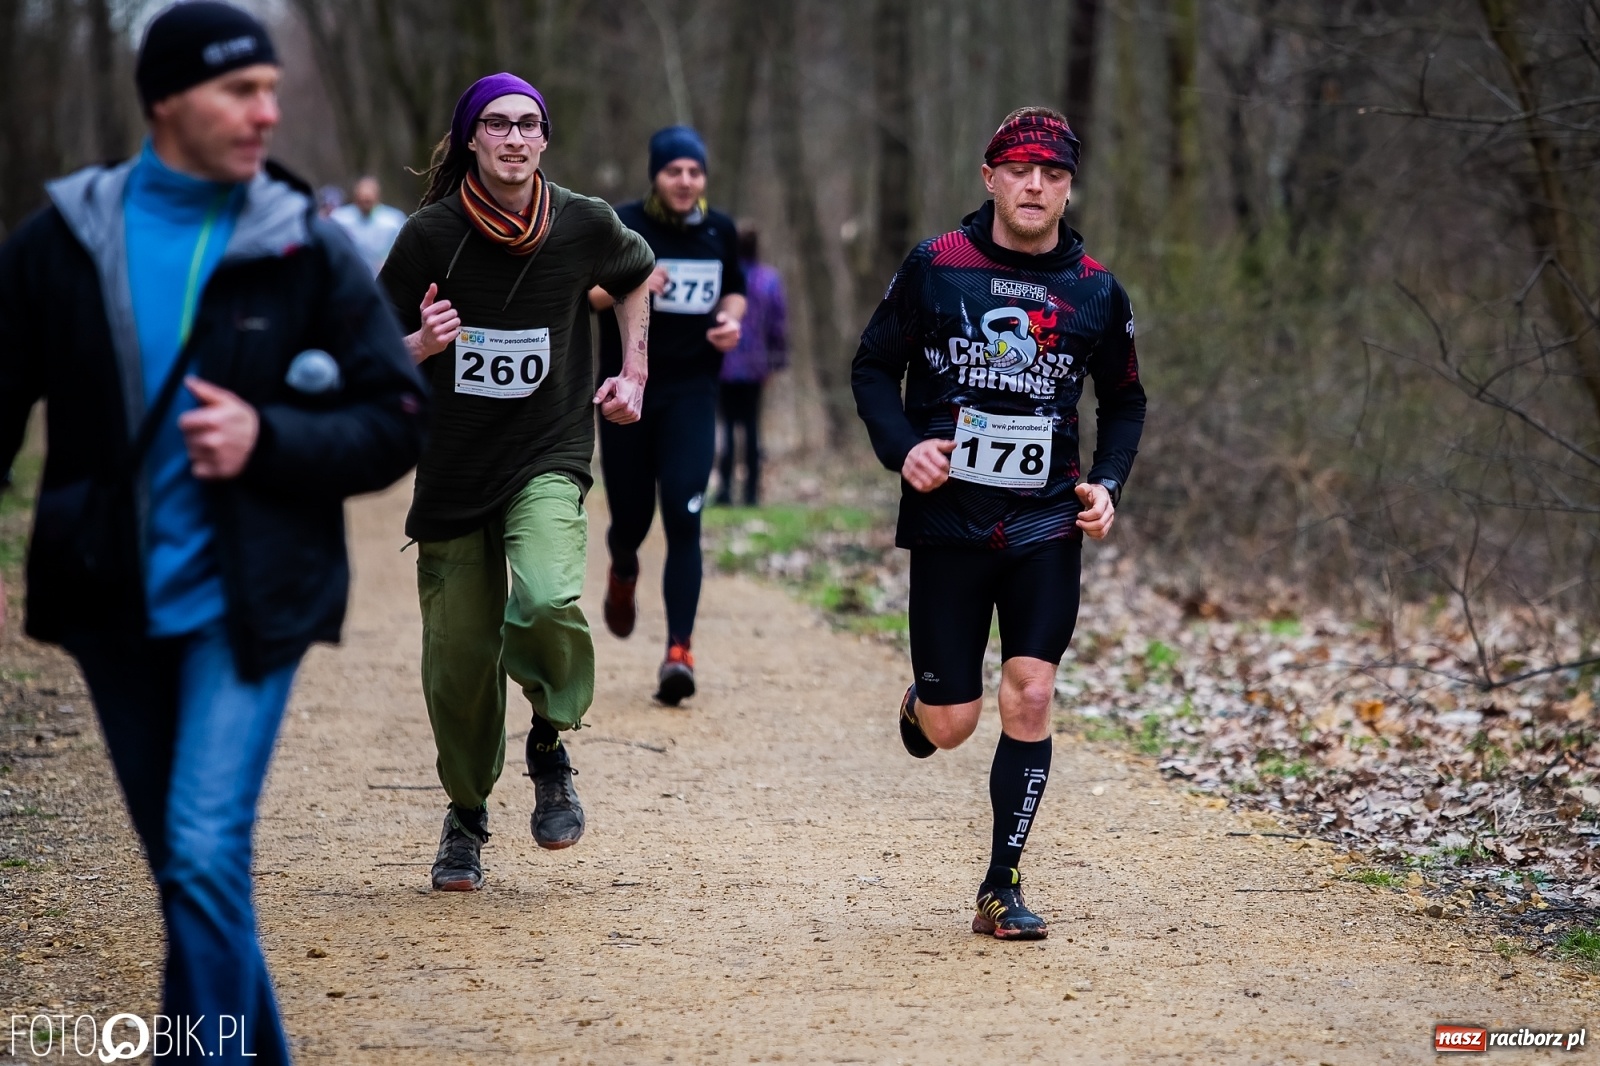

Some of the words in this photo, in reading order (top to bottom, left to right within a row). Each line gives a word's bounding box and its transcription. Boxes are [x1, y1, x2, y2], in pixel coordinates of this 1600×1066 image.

[660, 280, 714, 303] 275
[993, 280, 1044, 294] EXTREME
[489, 336, 546, 345] www.personalbest.pl
[461, 351, 544, 386] 260
[991, 422, 1049, 433] www.personalbest.pl
[961, 436, 1045, 476] 178
[1007, 768, 1047, 848] kalenji
